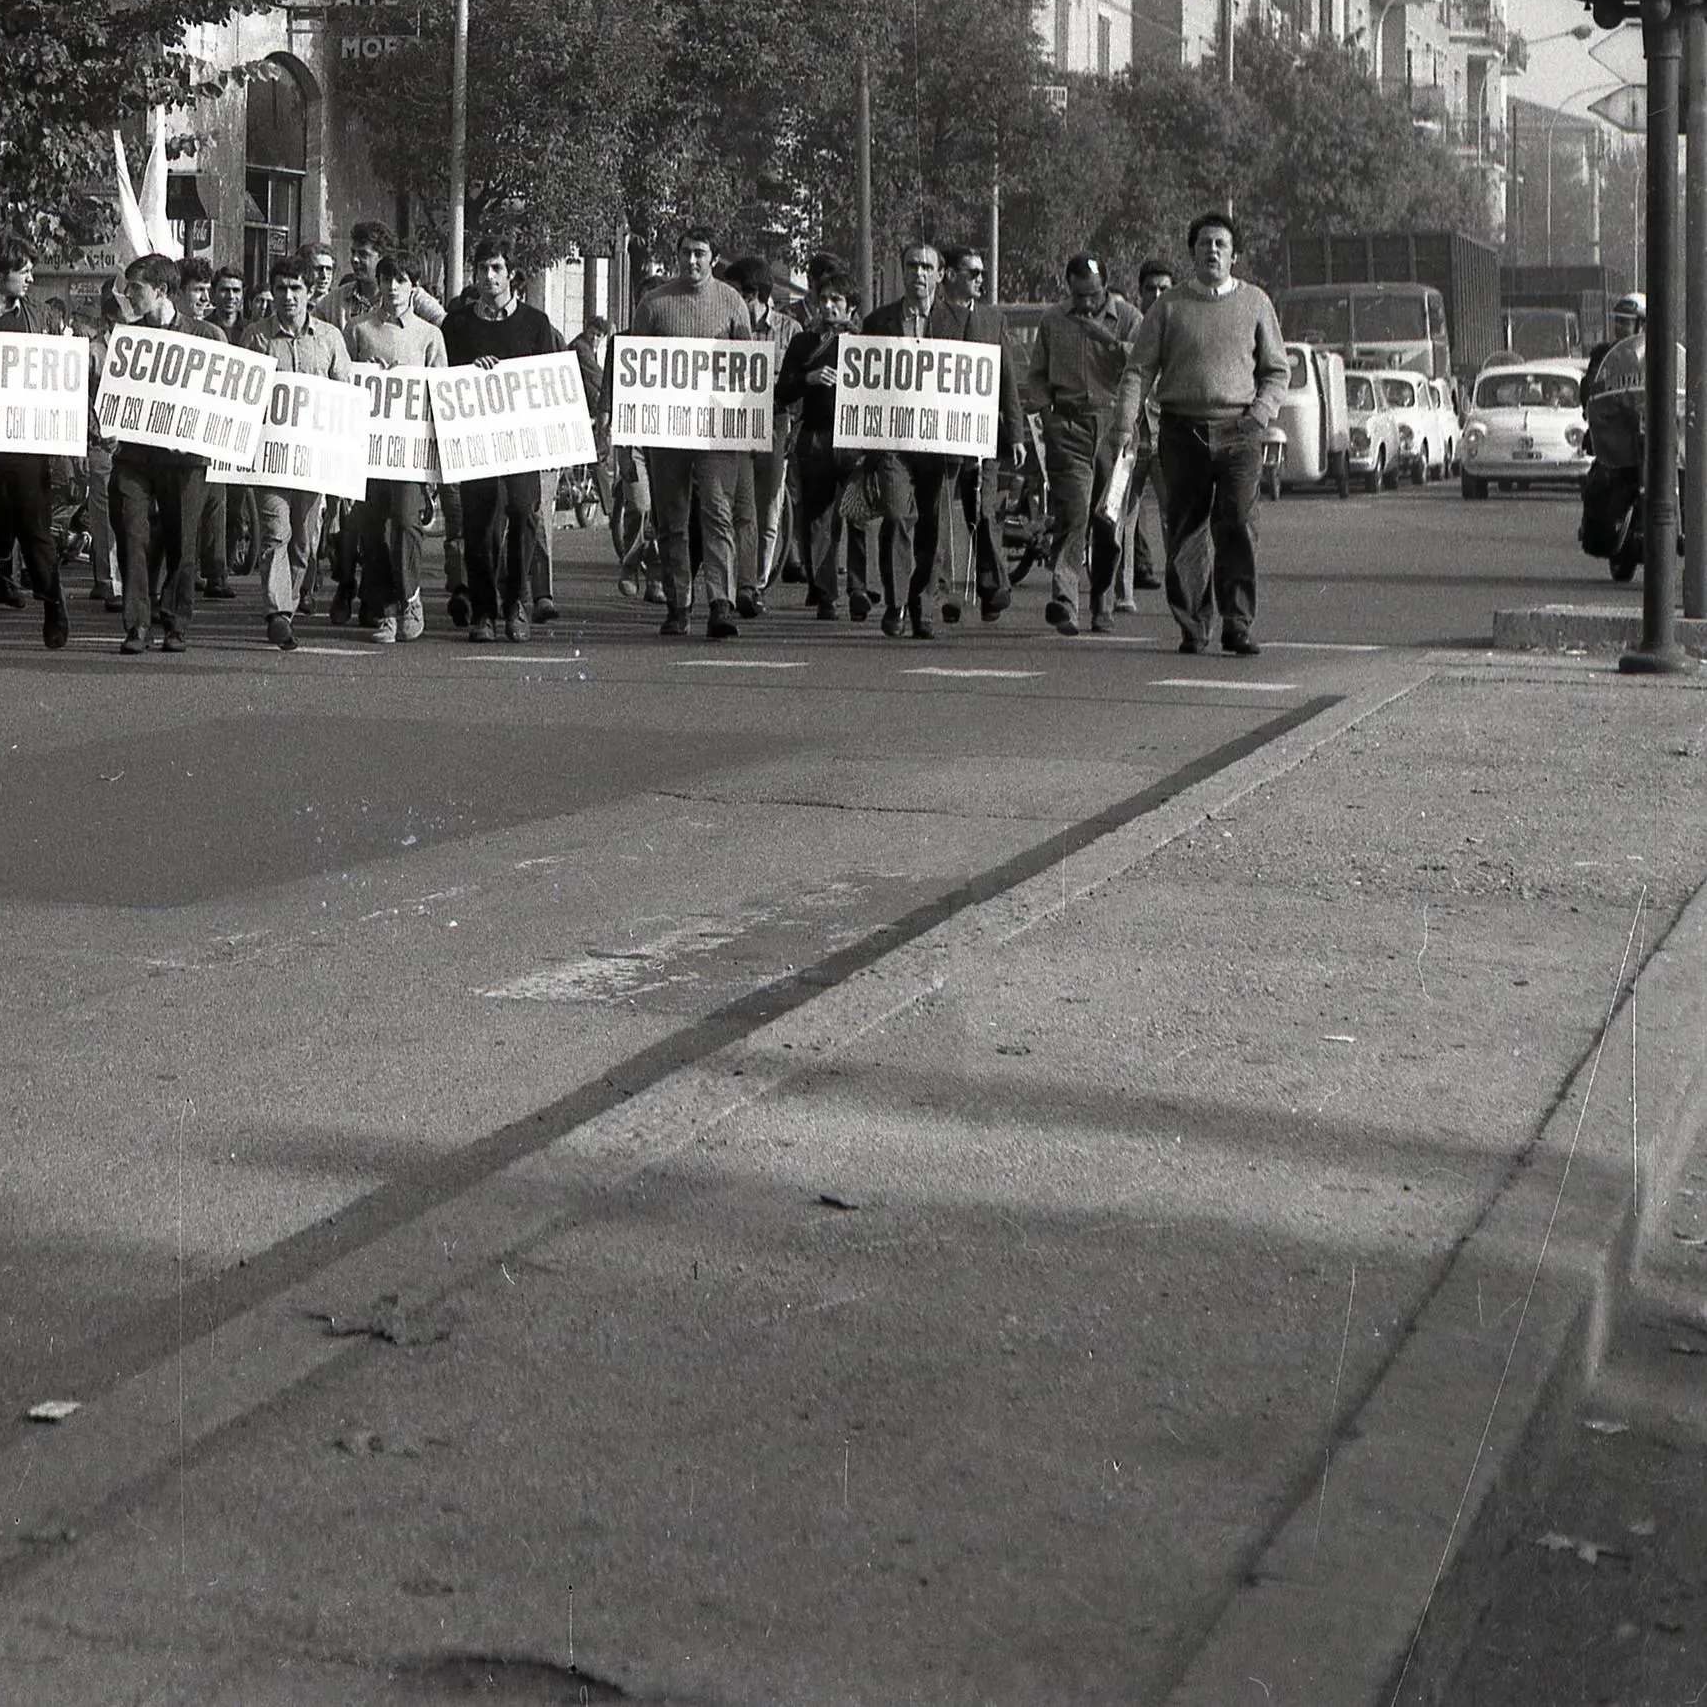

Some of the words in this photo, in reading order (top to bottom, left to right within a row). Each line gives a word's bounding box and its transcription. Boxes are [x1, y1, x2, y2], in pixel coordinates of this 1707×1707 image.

[109, 336, 266, 406] SCIOPERO
[620, 347, 768, 394] SCIOPERO
[843, 347, 993, 397] SCIOPERO
[98, 393, 120, 427] FIM
[120, 396, 144, 430] CISL
[146, 400, 176, 435] FIOM
[436, 364, 579, 422] SCIOPERO
[6, 406, 25, 440] CGIL
[618, 403, 636, 434] FIM
[642, 403, 661, 435] CISL
[667, 405, 691, 437] FIOM
[697, 406, 716, 438] CGIL
[722, 407, 747, 439] UILM
[752, 408, 766, 440] UIL
[840, 404, 859, 436] FIM
[863, 405, 883, 437] CISL
[889, 406, 915, 439] FIOM
